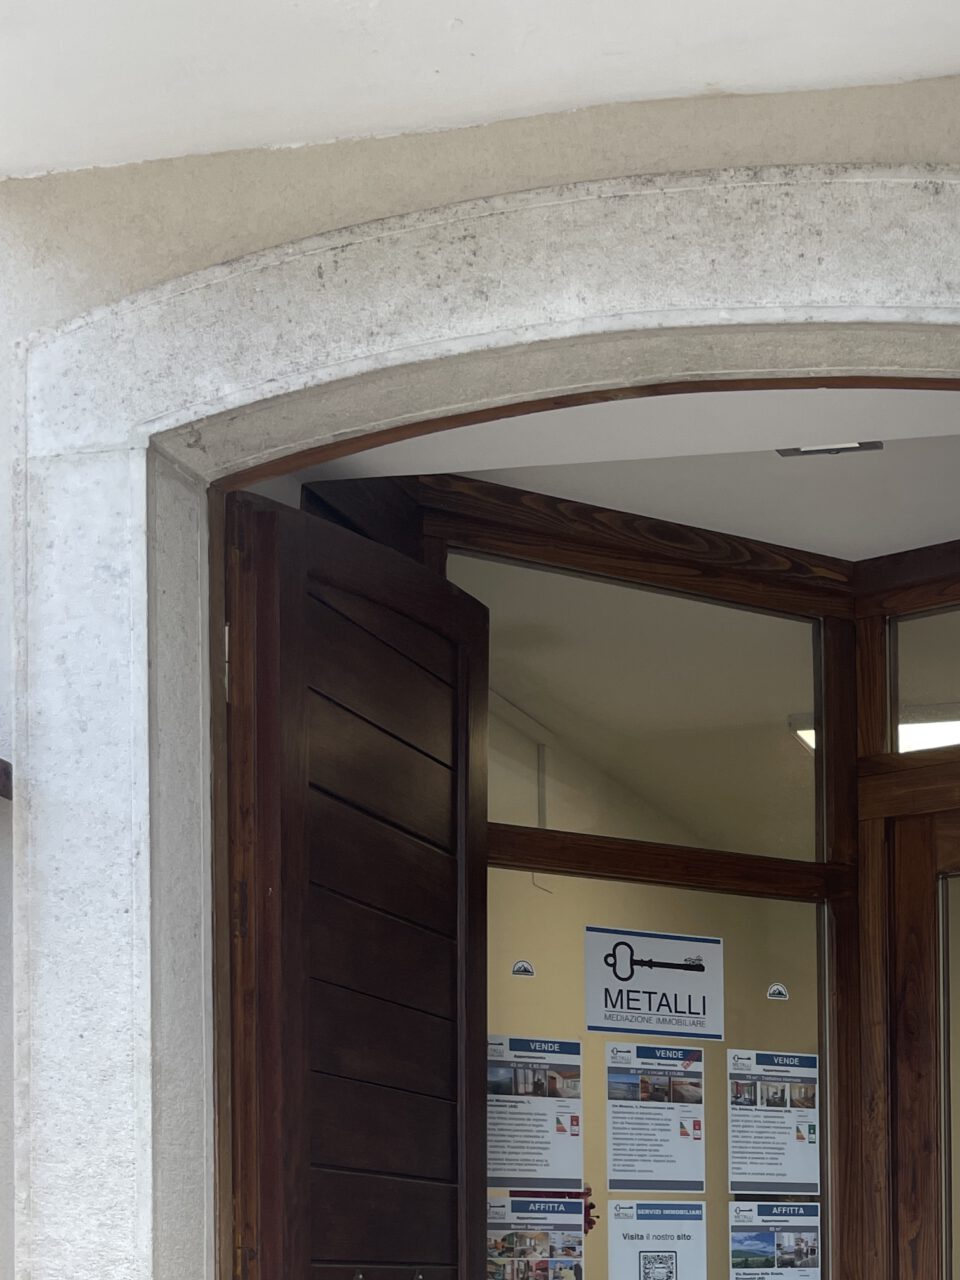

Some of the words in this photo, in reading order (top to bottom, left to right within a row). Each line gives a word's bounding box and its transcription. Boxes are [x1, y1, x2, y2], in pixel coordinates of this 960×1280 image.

[604, 987, 706, 1016] METALLI
[604, 1013, 653, 1024] MEDIAZIONE
[655, 1017, 706, 1028] IMMOBILIARE
[529, 1042, 561, 1052] VENDE
[655, 1049, 684, 1059] VENDE
[773, 1056, 800, 1065] VENDE
[528, 1203, 566, 1211] AFFITTA
[622, 1233, 644, 1241] Visita
[676, 1233, 692, 1241] sito
